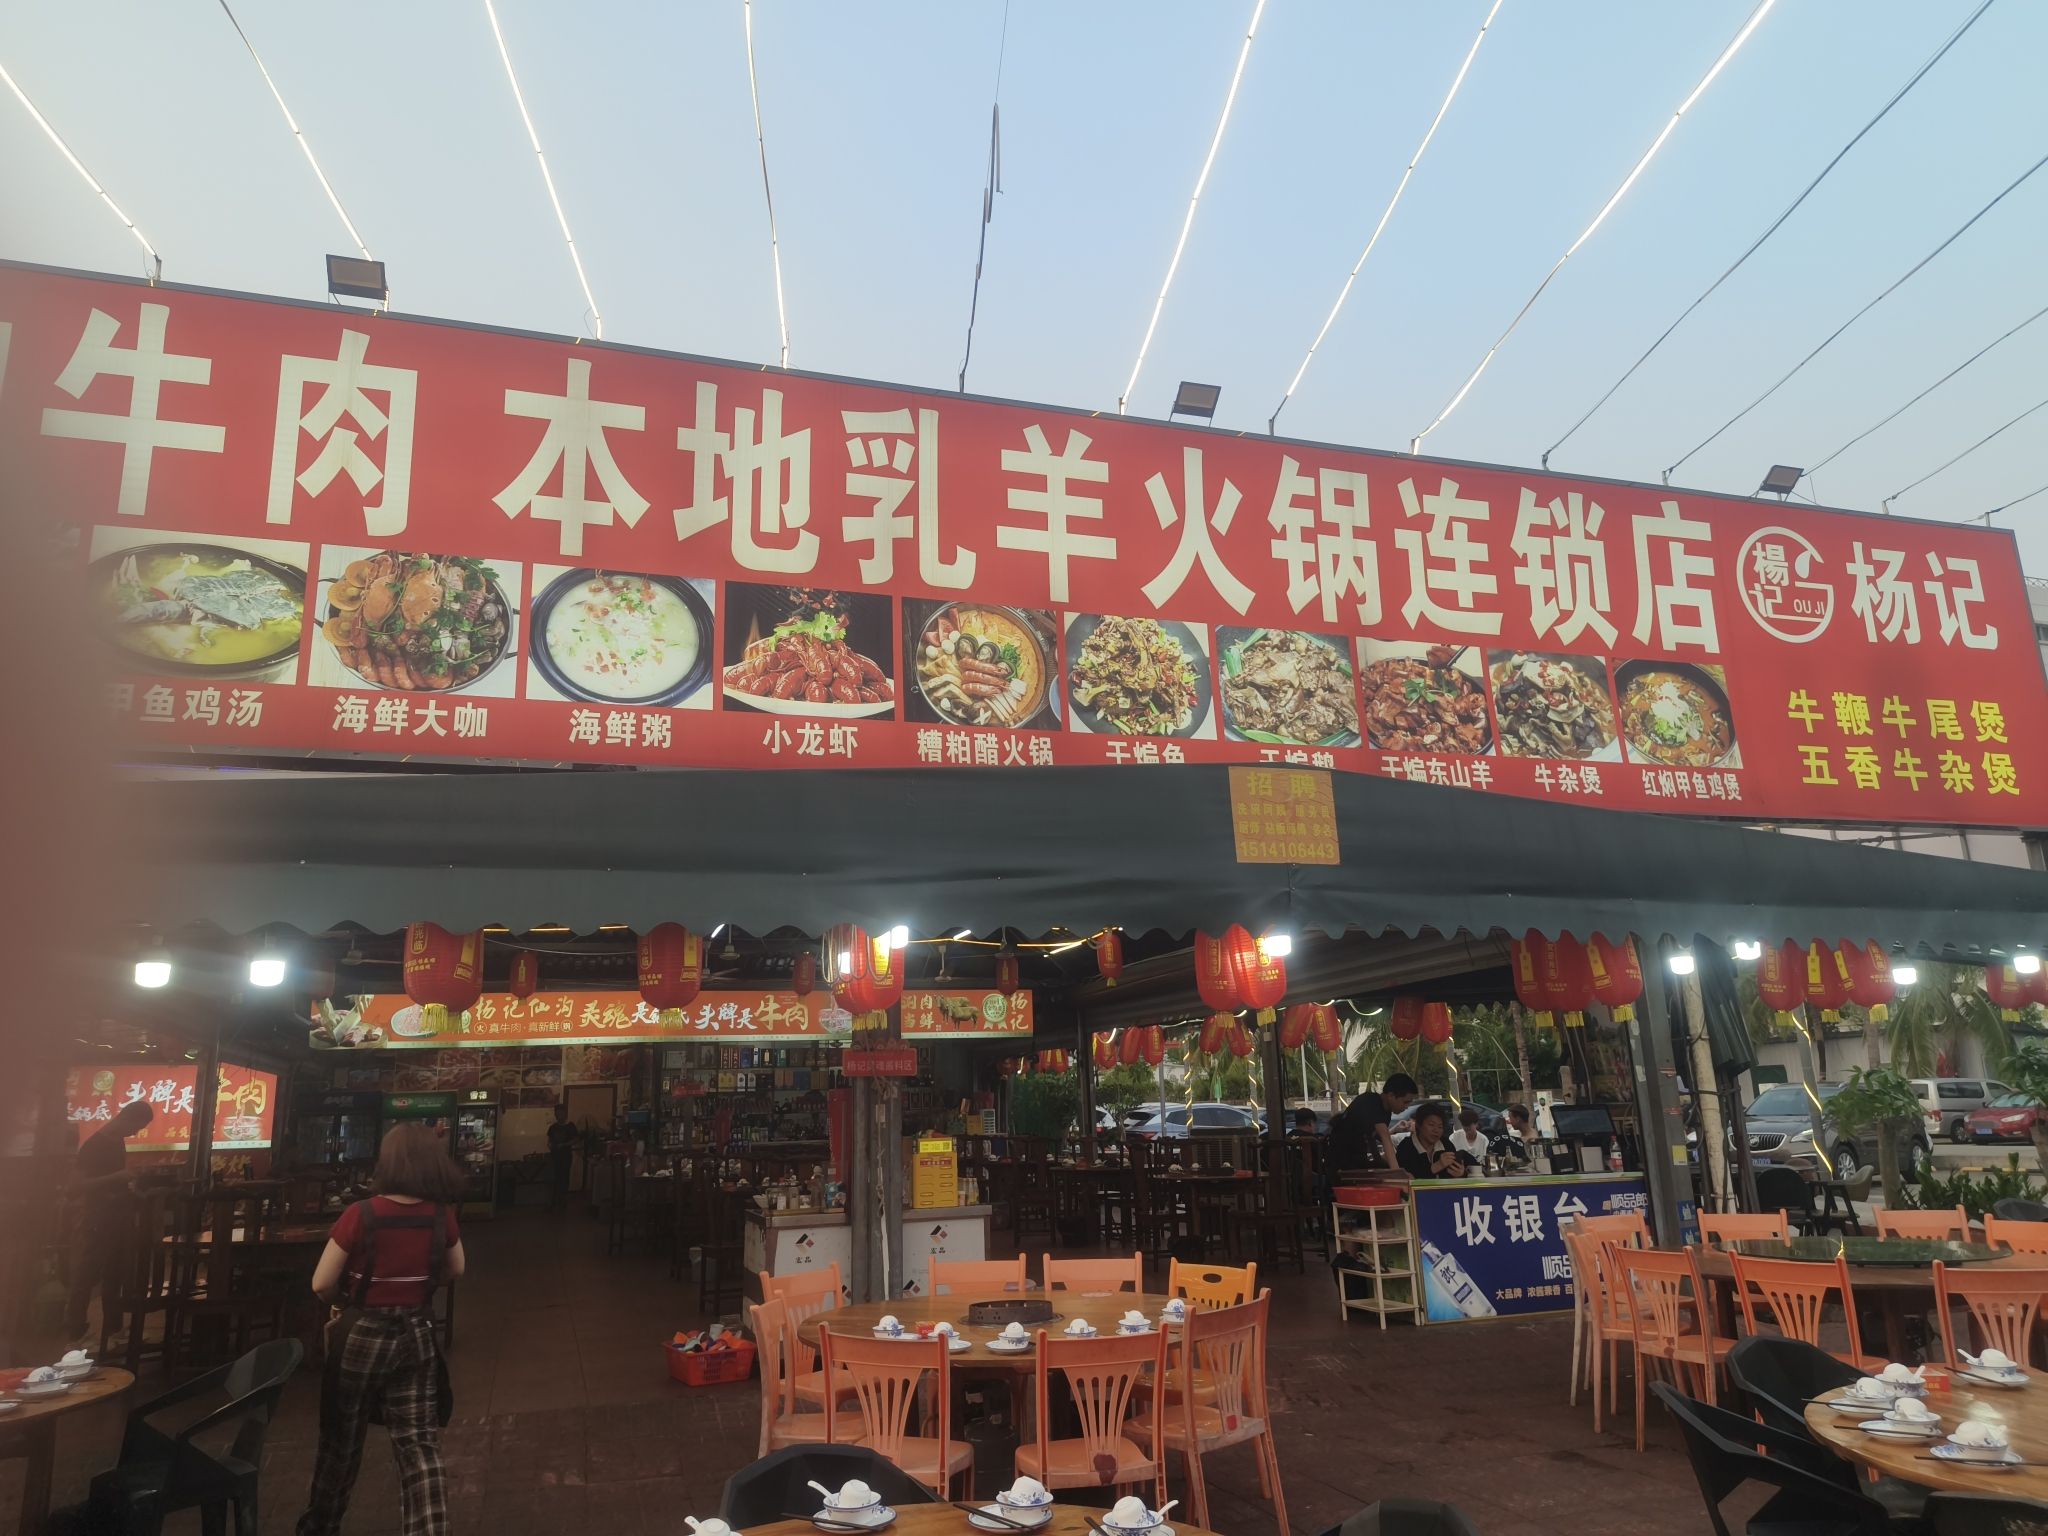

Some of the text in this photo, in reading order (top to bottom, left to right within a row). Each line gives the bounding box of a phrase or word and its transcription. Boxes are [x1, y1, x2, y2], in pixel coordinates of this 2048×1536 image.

[0, 303, 419, 537] 牛肉
[1846, 541, 1999, 651] 杨记
[332, 694, 489, 738] 海鲜大咖
[568, 708, 673, 749] 海鲜粥
[1787, 689, 2010, 745] 牛鞭牛尾煲
[761, 721, 860, 759] 小龙虾
[916, 728, 1055, 767] 糟粕醋火锅
[1534, 764, 1604, 796] 牛杂煲
[1801, 745, 2021, 795] 五香牛杂煲
[1453, 1191, 1590, 1247] 收银台
